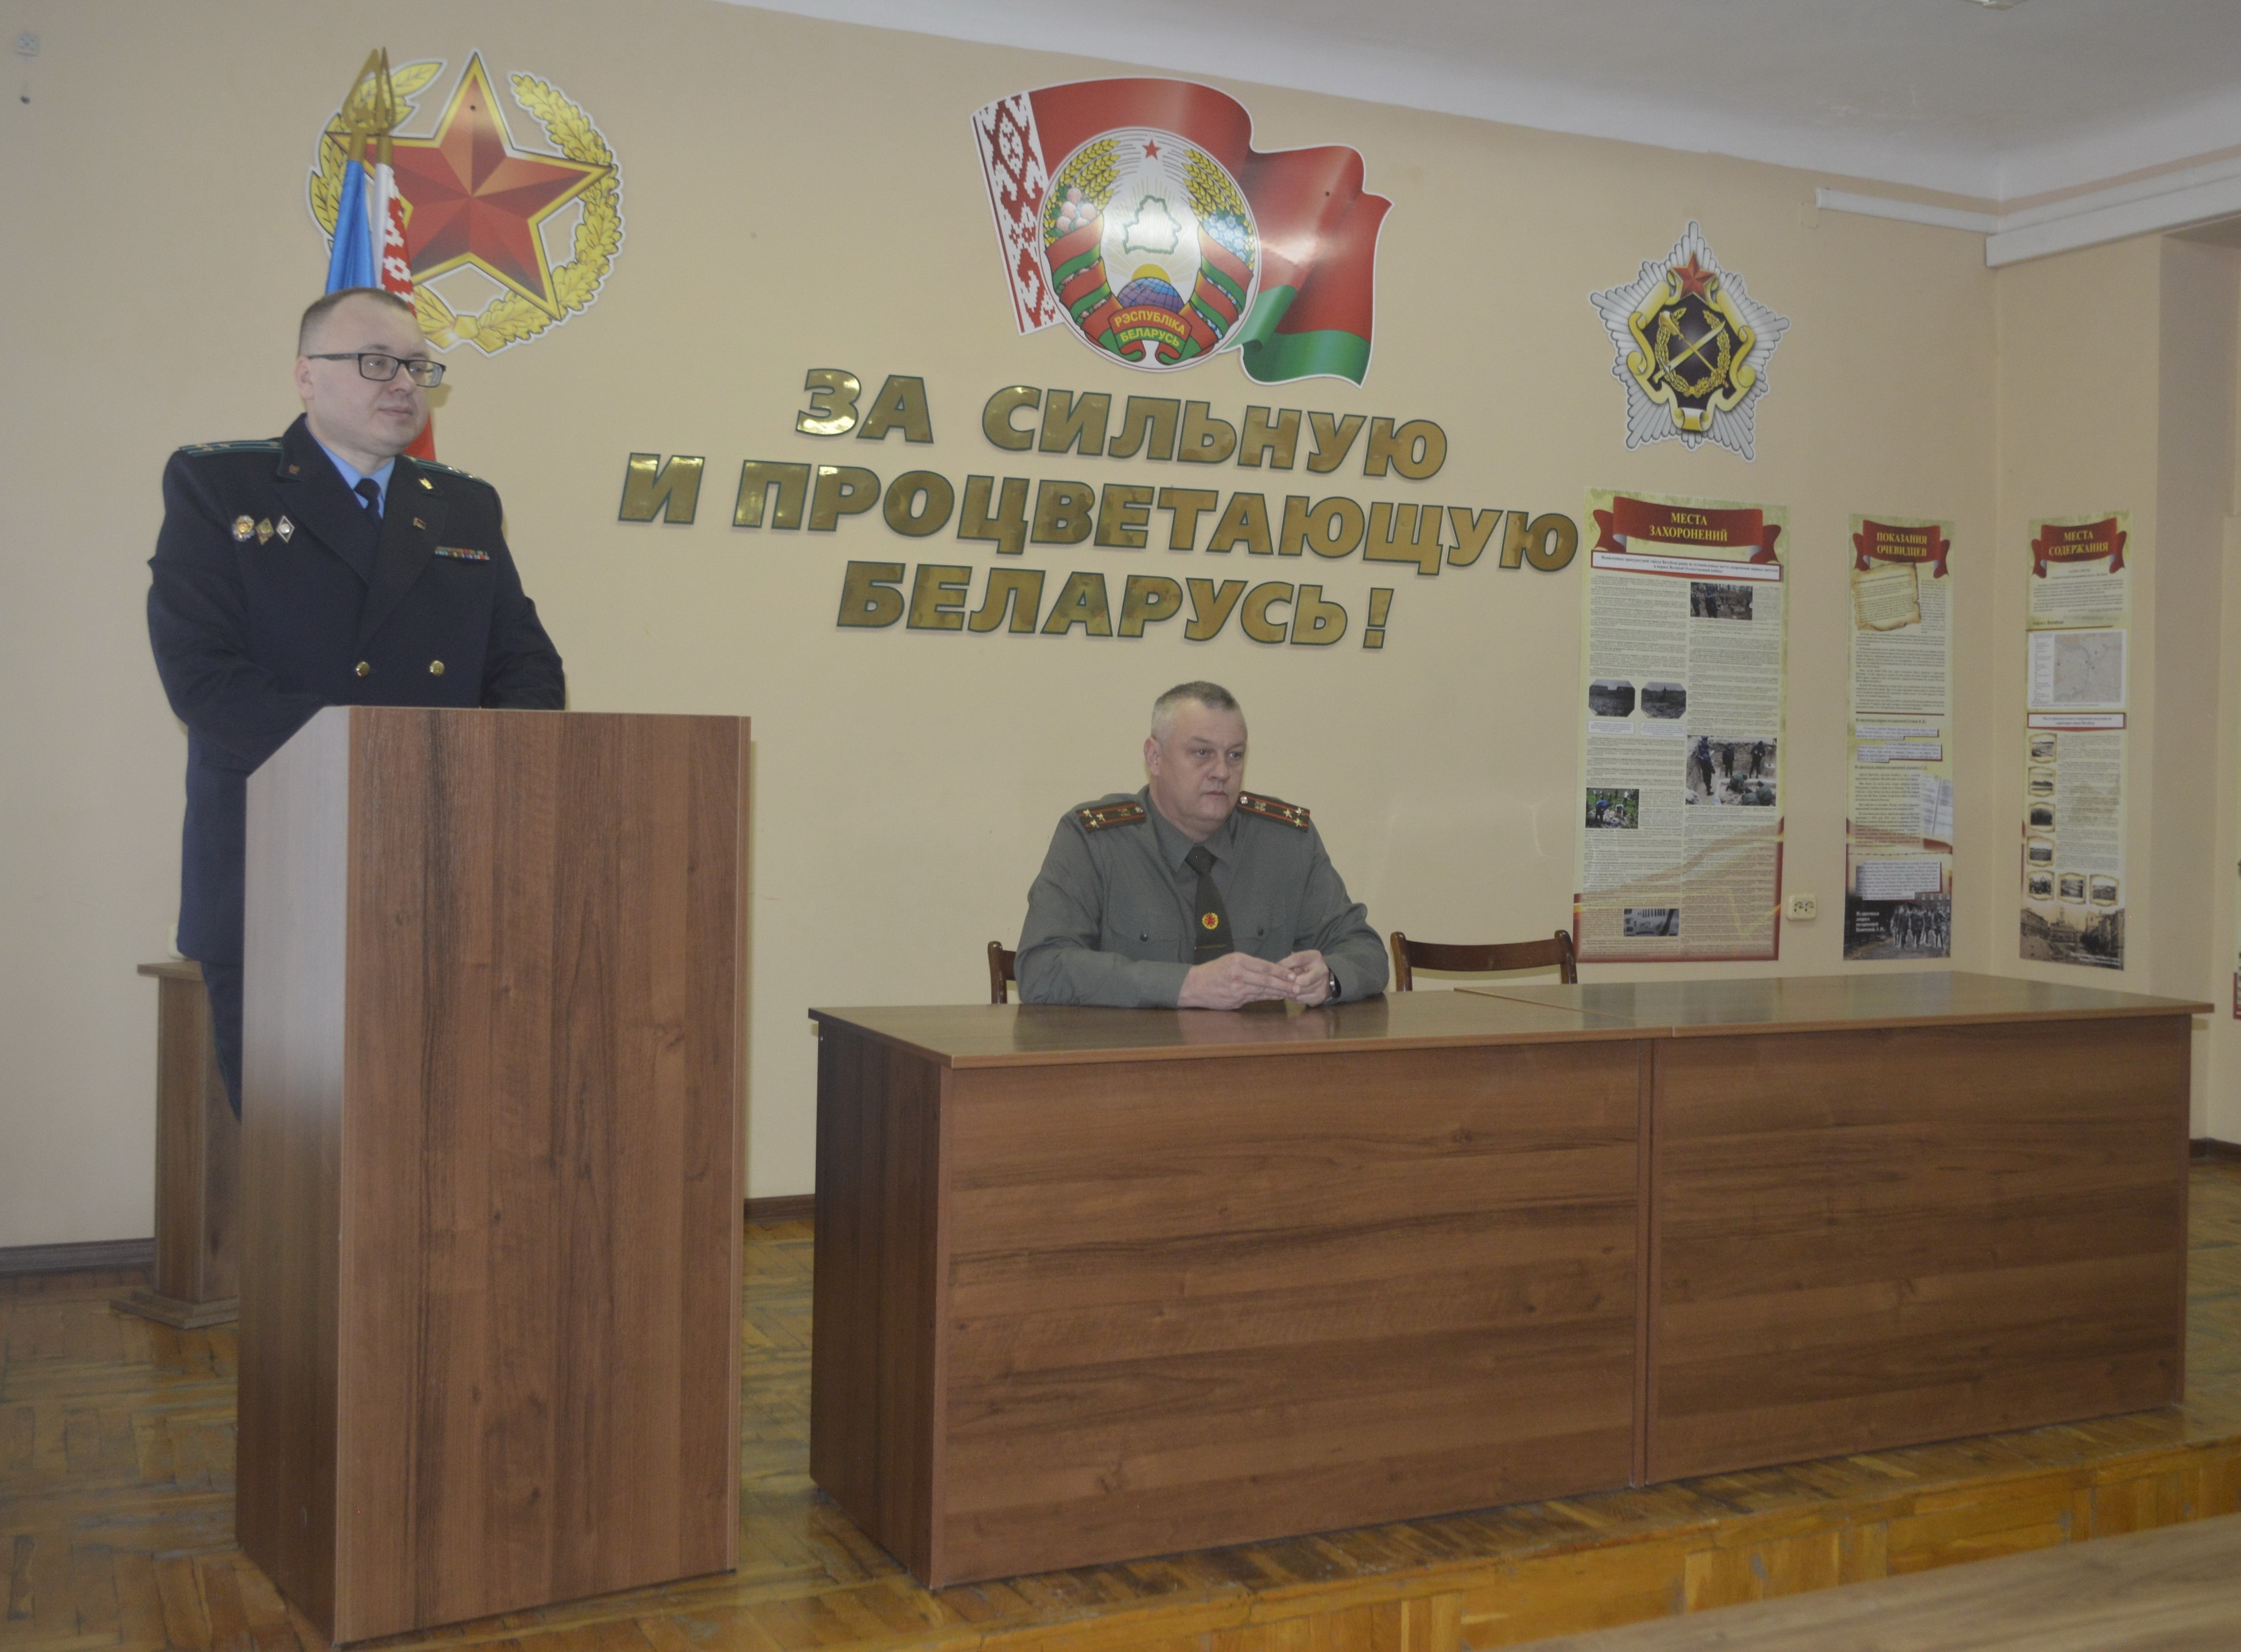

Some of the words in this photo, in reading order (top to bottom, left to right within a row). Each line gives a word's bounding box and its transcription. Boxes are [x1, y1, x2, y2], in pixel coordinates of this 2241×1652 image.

[1114, 310, 1185, 335] РЭСПУБЛІКА
[1120, 327, 1180, 346] БЕЛАРУСЬ
[795, 368, 934, 444] ЗА
[982, 385, 1447, 480] СИЛЬНУЮ
[618, 452, 705, 525] И
[732, 459, 1578, 576] ПРОЦВЕТАЮЩУЮ
[1671, 512, 1707, 525] МЕСТА
[1650, 525, 1728, 542] ЗАХОРОНЕНИЙ
[1877, 532, 1927, 544] ПОКАЗАНИЯ
[2064, 531, 2094, 541] МЕСТА
[1877, 545, 1927, 557] ОЧЕВИДЦЕВ
[2049, 542, 2108, 556] СОДЕРЖАНИЯ
